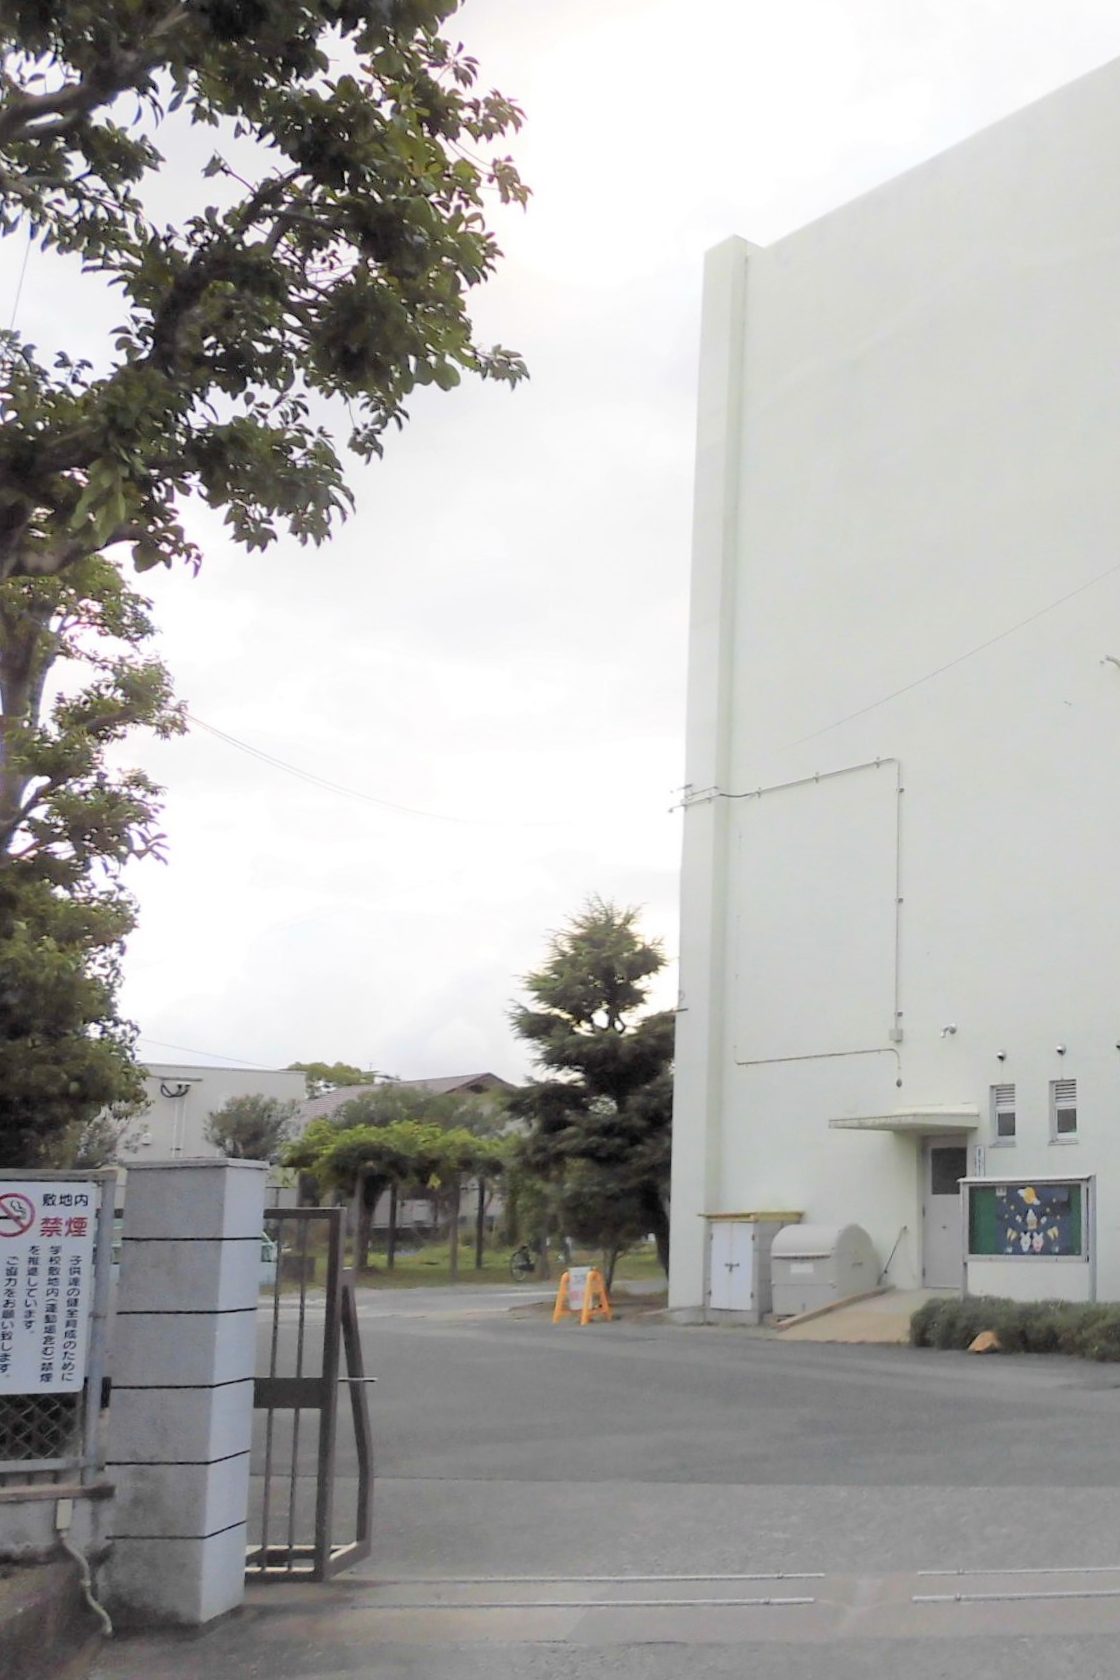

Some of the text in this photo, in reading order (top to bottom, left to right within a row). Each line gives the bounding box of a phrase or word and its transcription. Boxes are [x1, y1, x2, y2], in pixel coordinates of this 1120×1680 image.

[42, 1193, 89, 1207] 敷地内
[40, 1215, 89, 1237] 禁煙
